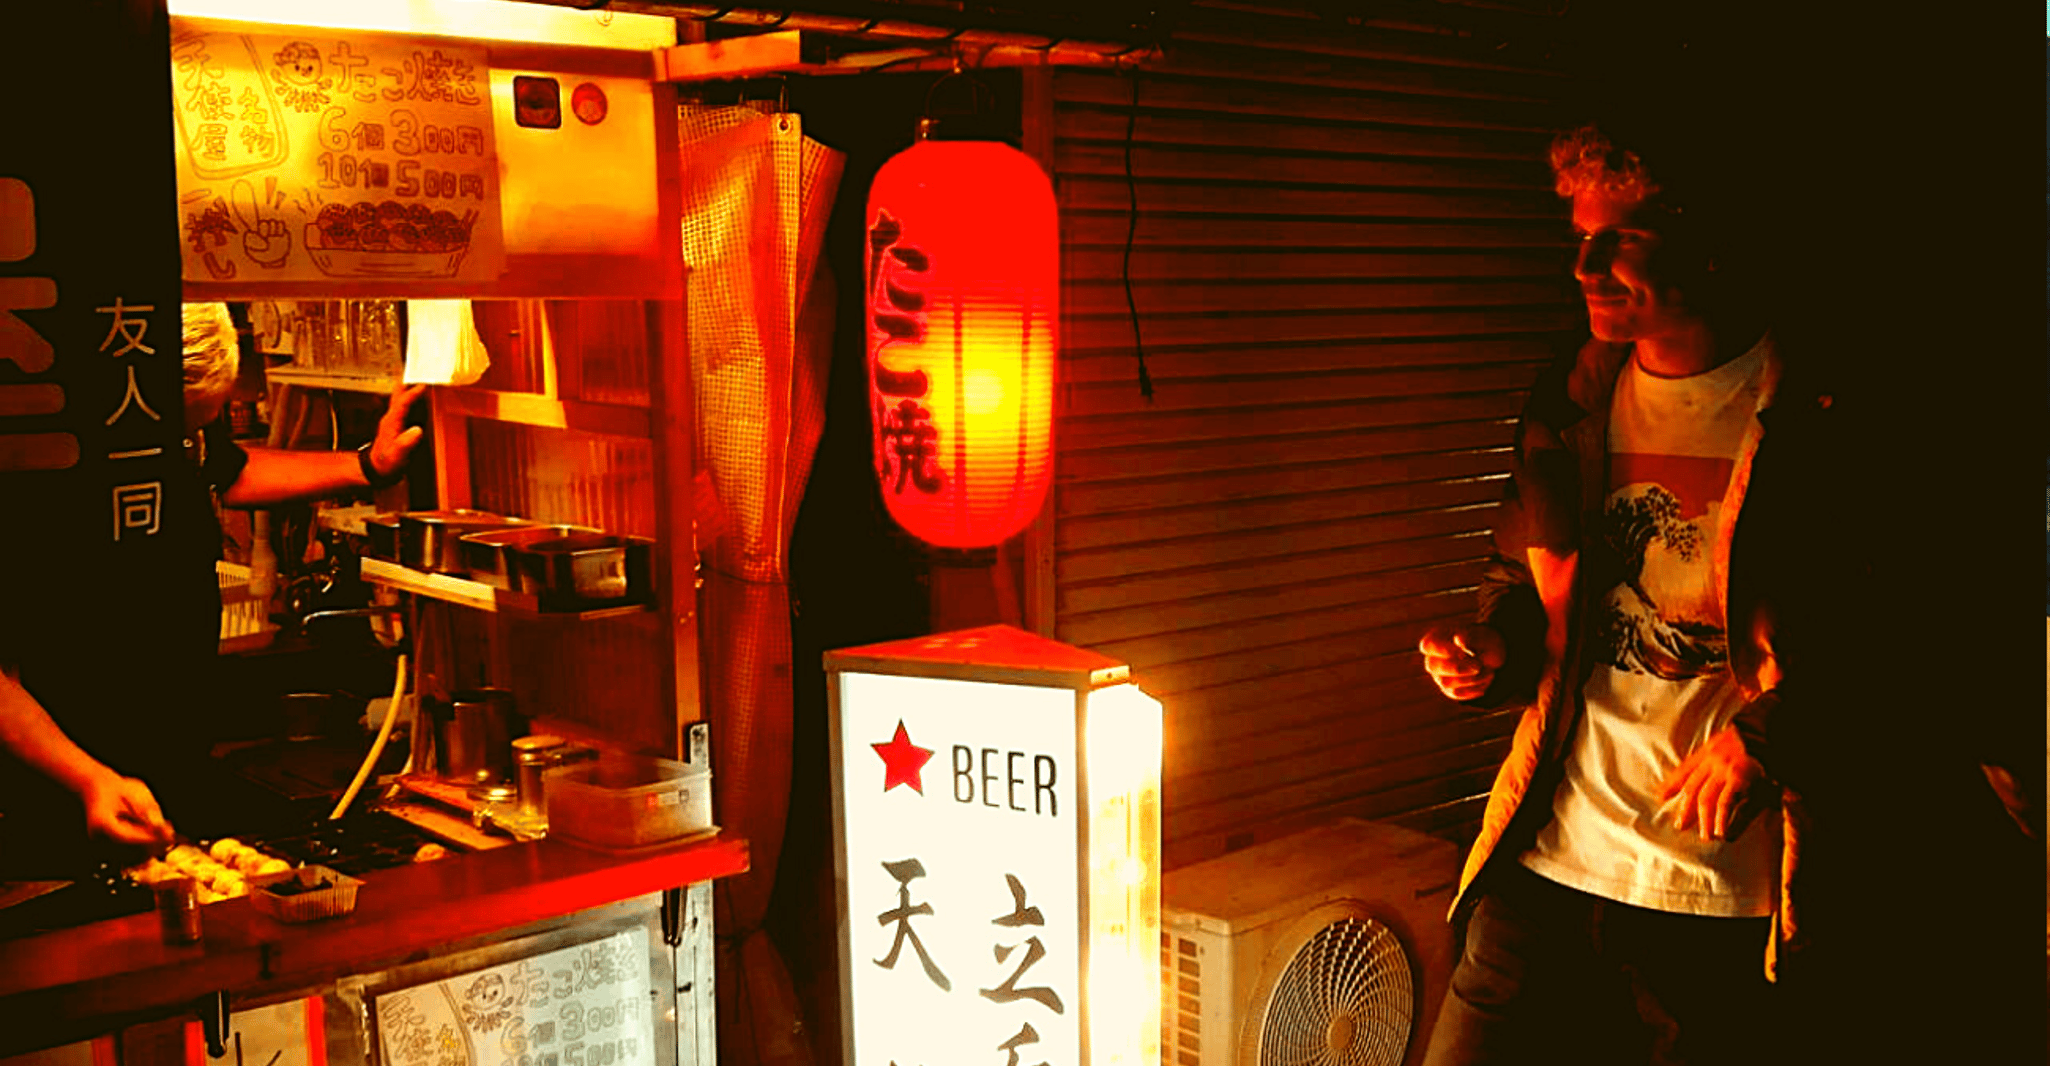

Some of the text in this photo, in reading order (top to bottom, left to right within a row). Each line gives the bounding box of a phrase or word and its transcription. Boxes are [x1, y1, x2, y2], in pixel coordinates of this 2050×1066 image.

[328, 40, 481, 106] たこ焼き
[318, 106, 484, 156] 6個 300円
[317, 151, 484, 201] 10個 500円
[869, 207, 943, 495] たこ焼
[95, 296, 163, 541] 友人一同
[952, 744, 1058, 818] BEER
[872, 857, 952, 1066] 天
